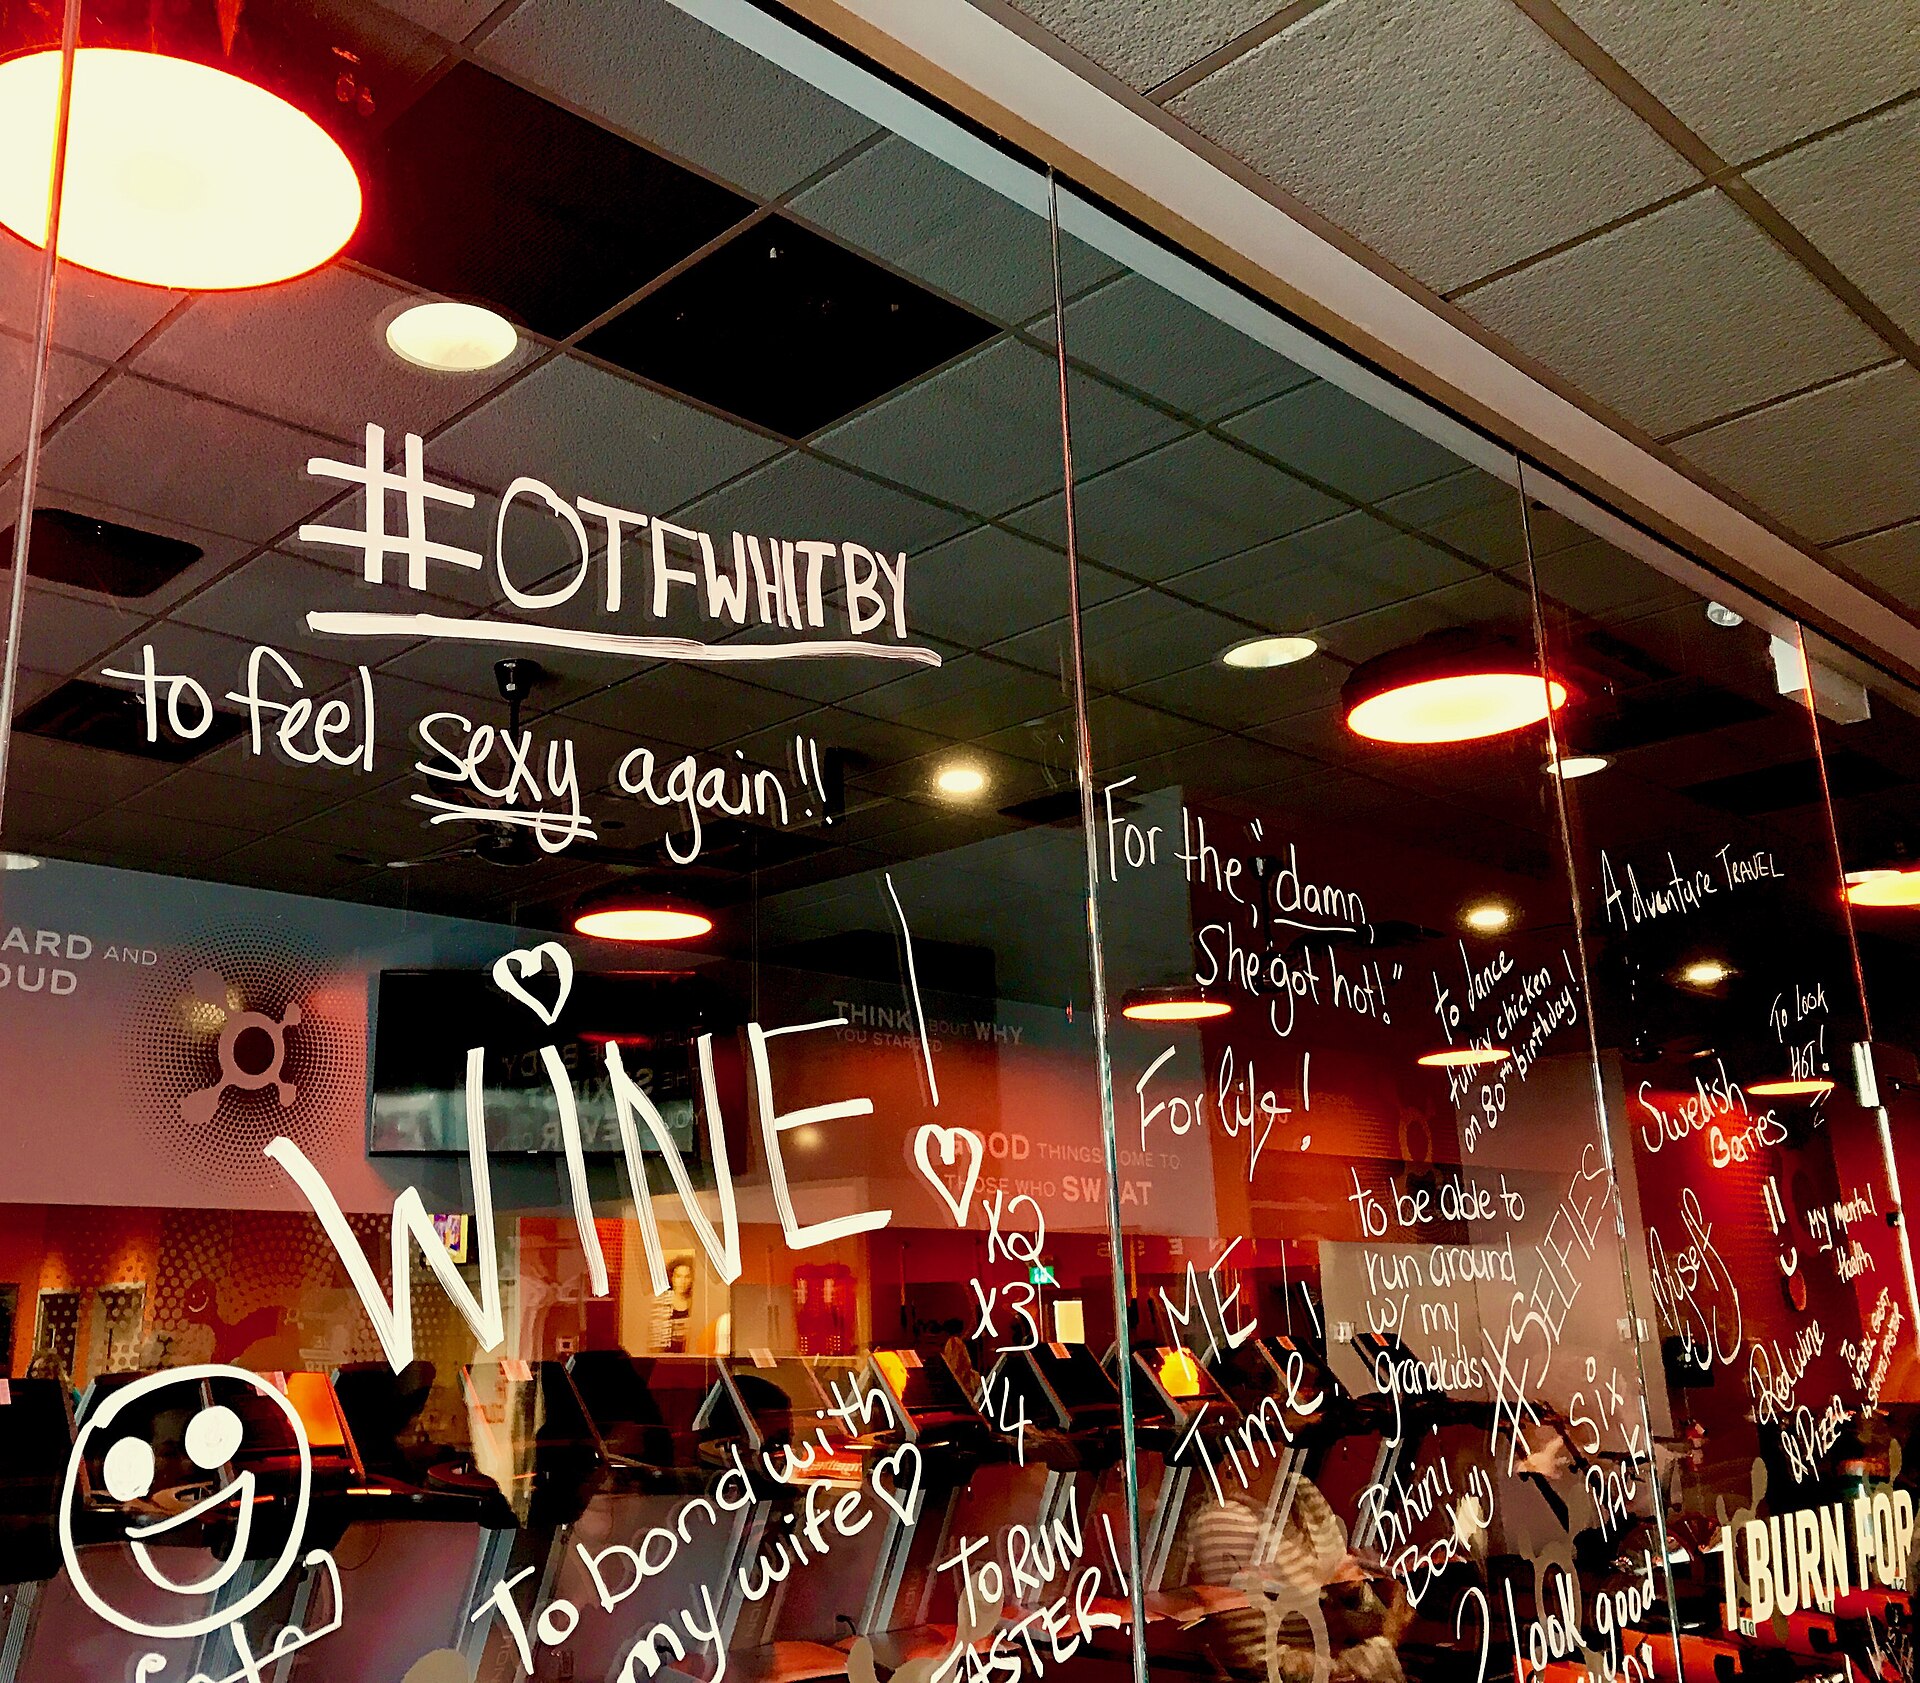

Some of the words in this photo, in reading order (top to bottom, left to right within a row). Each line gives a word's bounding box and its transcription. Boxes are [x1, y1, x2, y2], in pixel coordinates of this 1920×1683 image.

[299, 423, 907, 638] #OTFWHITBY
[102, 644, 213, 743] to
[227, 646, 373, 771] feel
[414, 712, 582, 853] sexy
[1105, 776, 1162, 882] For
[1601, 849, 1717, 931] Adventure
[1716, 844, 1784, 891] TRAVEL
[103, 946, 158, 965] AND
[1196, 922, 1260, 996] She
[1271, 946, 1319, 1036] got
[1459, 939, 1513, 1011] dance
[831, 1001, 913, 1031] THINK
[922, 1017, 972, 1036] BOUT
[974, 1021, 1023, 1046] WHY
[834, 1027, 868, 1044] YOU
[873, 1031, 943, 1053] STARTD
[1497, 968, 1551, 1039] chicken
[1136, 1046, 1203, 1152] For
[1464, 1115, 1481, 1153] on
[1639, 1057, 1747, 1152] Swedish
[1014, 1179, 1056, 1197] WHO
[1062, 1174, 1152, 1206] SWAT
[1036, 1142, 1104, 1164] THINGS
[1119, 1151, 1155, 1168] OME
[1159, 1153, 1181, 1170] TO
[1390, 1177, 1433, 1226] be
[1441, 1174, 1497, 1221] able
[1500, 1174, 1525, 1221] to
[1364, 1250, 1422, 1295] run
[1429, 1231, 1517, 1287] around
[1421, 1302, 1460, 1357] my
[1750, 1340, 1797, 1425] Red
[471, 1566, 580, 1675] To
[576, 1444, 757, 1613] bond
[764, 1370, 896, 1483] with
[1007, 1486, 1083, 1599] RUN
[1721, 1525, 1738, 1632] I
[1746, 1503, 1850, 1624] BURN
[1854, 1489, 1914, 1592] FOR
[616, 1584, 727, 1683] my
[738, 1477, 874, 1603] wife
[1596, 1550, 1656, 1681] good
